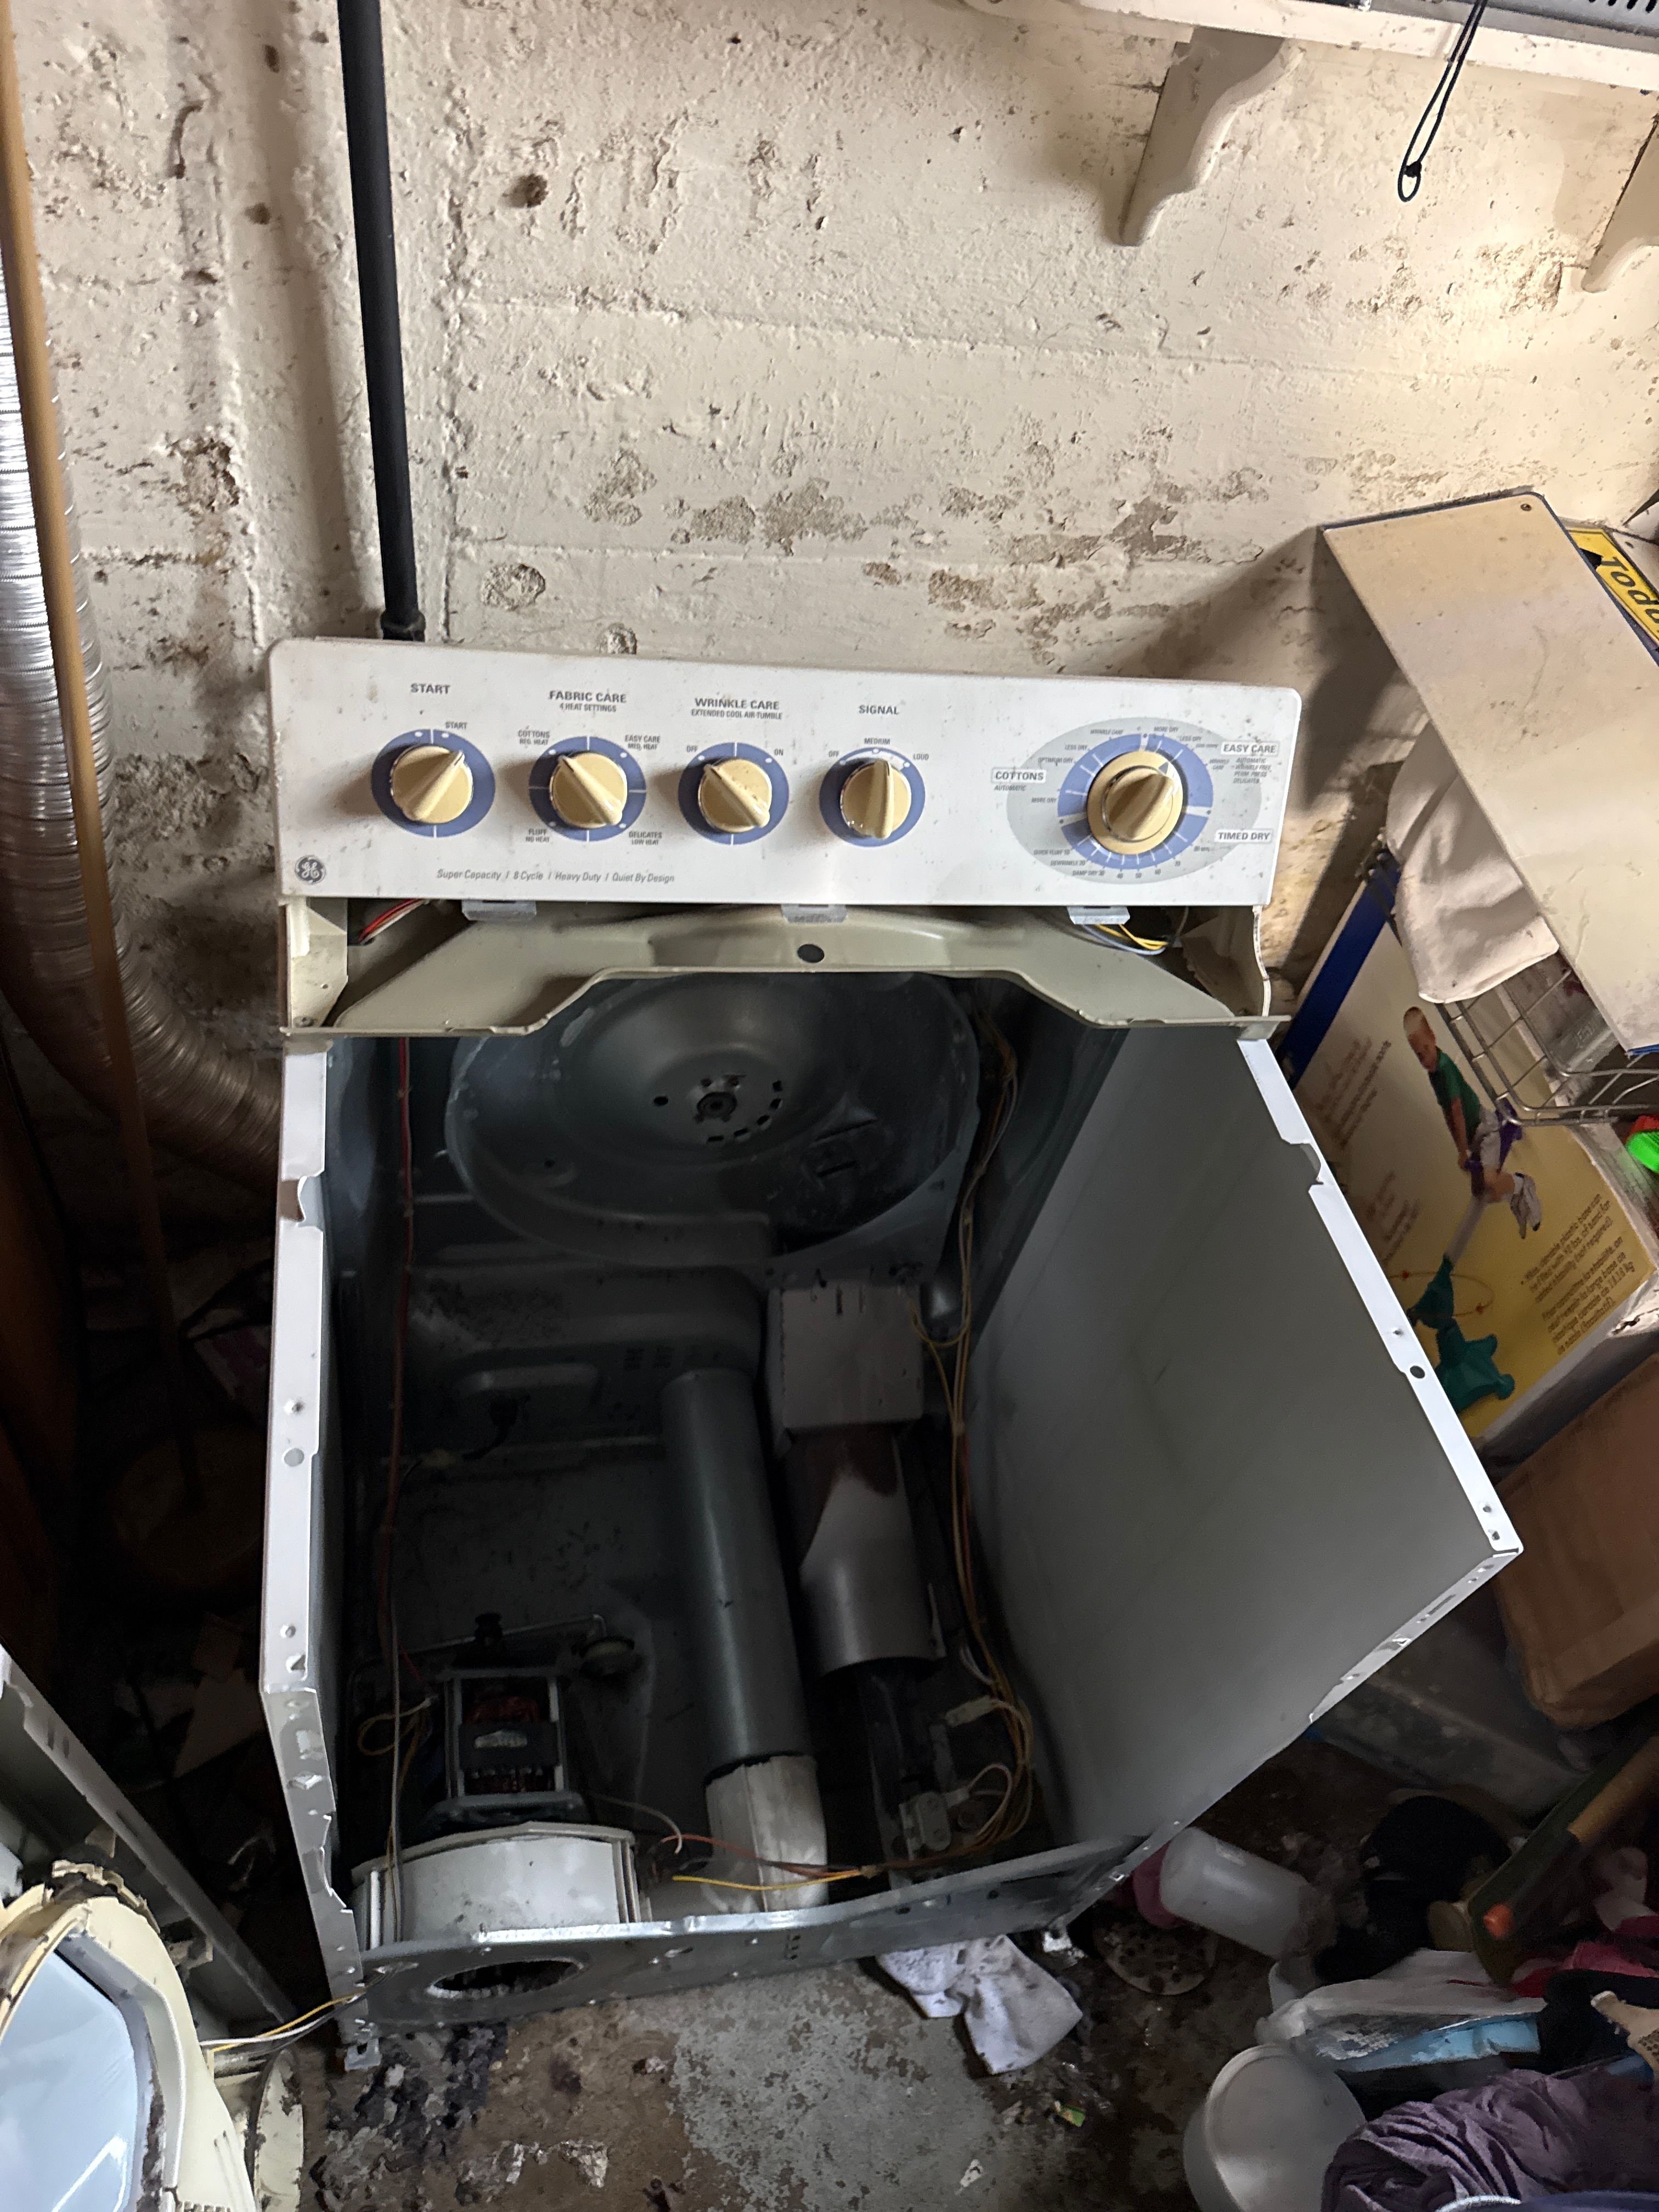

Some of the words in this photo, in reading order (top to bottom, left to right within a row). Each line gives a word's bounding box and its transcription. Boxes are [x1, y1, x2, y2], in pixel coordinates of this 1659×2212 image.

[1601, 556, 1659, 633] Toda
[410, 683, 451, 694] START
[549, 690, 592, 702] FABRIC
[596, 692, 627, 703] CARE
[584, 704, 617, 712] SETTINGS
[695, 697, 747, 709] WRINKLE
[751, 700, 780, 710] CARE
[691, 708, 725, 718] EXTENDED
[859, 704, 900, 715] SIGNAL
[444, 721, 467, 730] START
[518, 730, 550, 738] COTTONS
[625, 735, 642, 743] EASY
[644, 735, 661, 743] CARE
[774, 748, 783, 757] ON
[1223, 744, 1249, 753] EASY
[1251, 744, 1276, 753] CARE
[995, 771, 1043, 780] COTTONS
[629, 831, 662, 839] DELICATES
[1218, 832, 1248, 840] TIMED
[1250, 832, 1270, 840] DRY
[437, 869, 462, 879] Super
[465, 870, 501, 881] Capacity
[514, 871, 519, 880] 8
[521, 871, 543, 881] Cycle
[555, 871, 580, 882] Heavy
[582, 872, 601, 882] Duty
[612, 872, 634, 882] Quiet
[635, 873, 647, 883] By
[647, 873, 675, 884] Design
